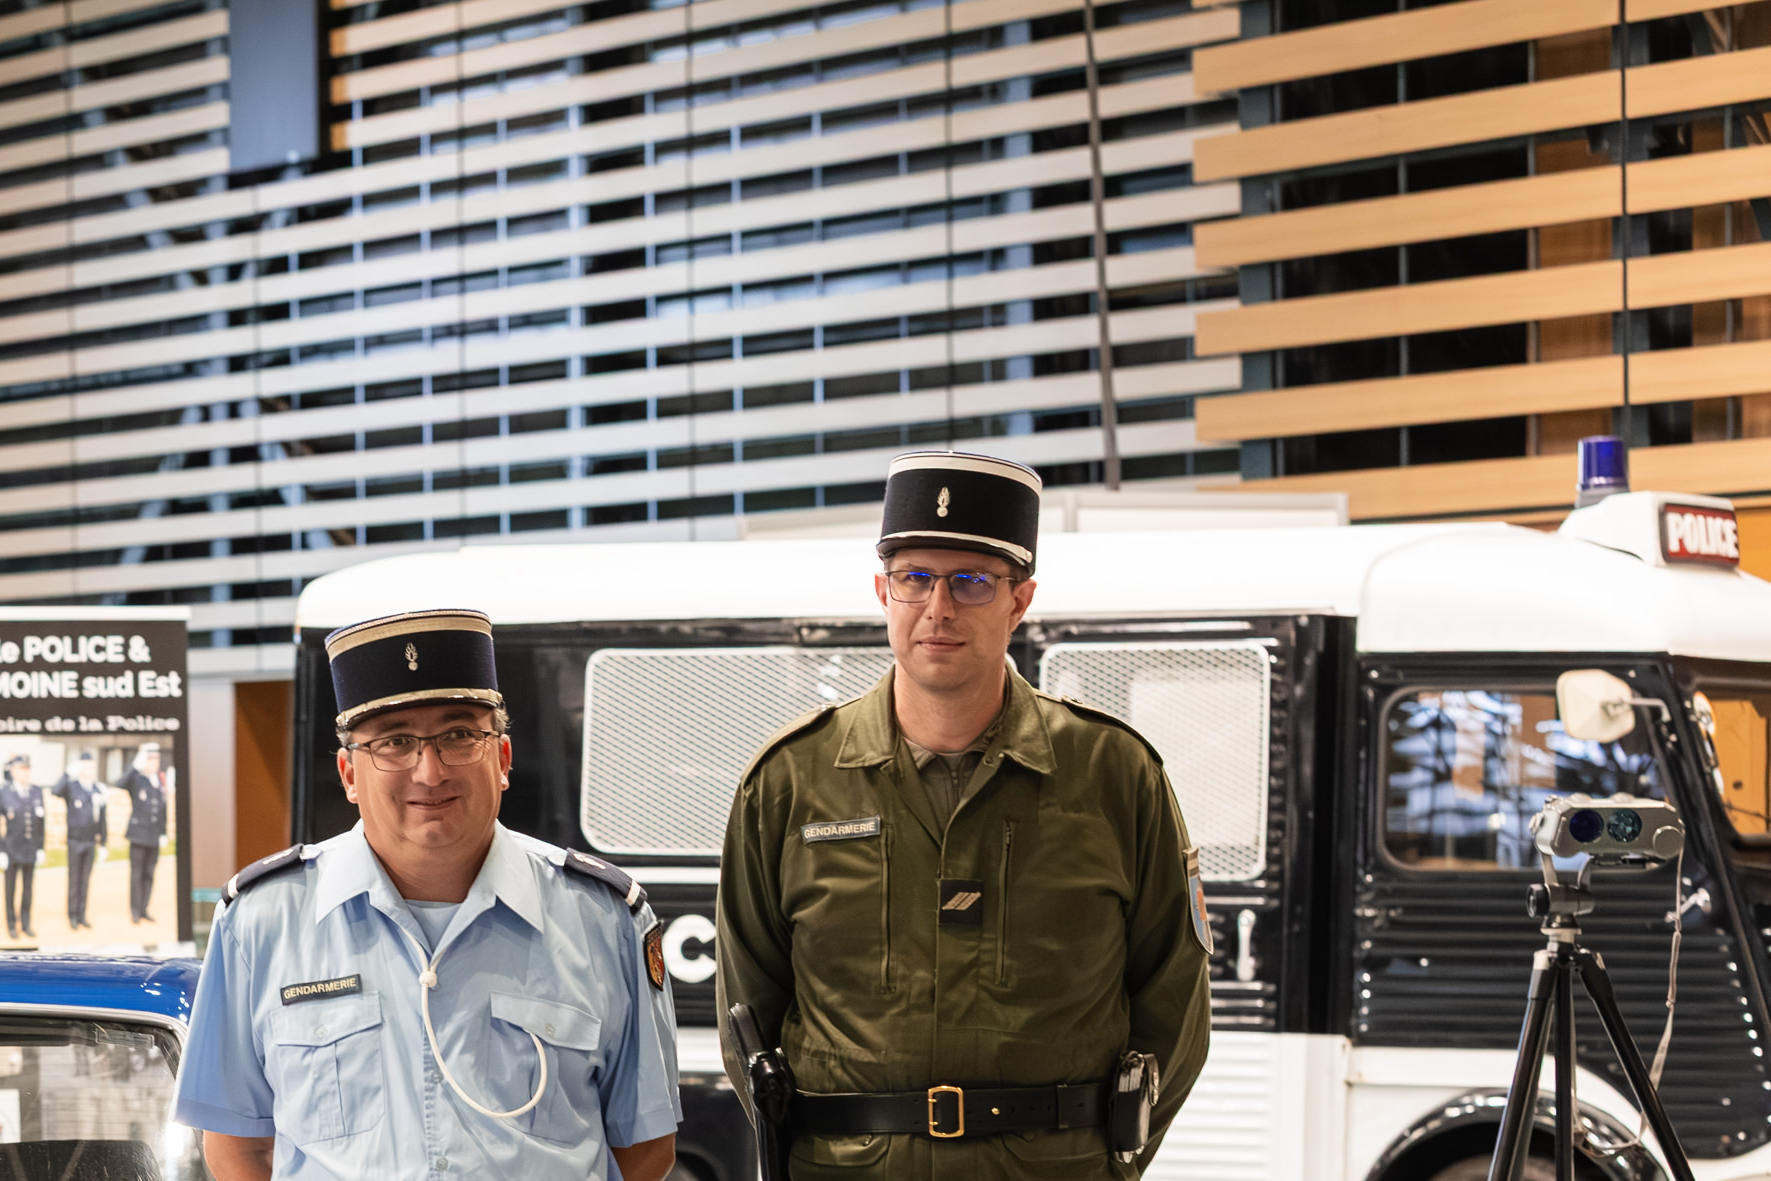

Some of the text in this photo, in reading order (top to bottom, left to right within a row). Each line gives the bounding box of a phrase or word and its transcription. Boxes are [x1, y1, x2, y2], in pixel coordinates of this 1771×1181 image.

[1666, 511, 1739, 558] POLICE
[24, 635, 125, 663] POLICE
[128, 635, 151, 663] &
[82, 670, 134, 699] sud
[138, 670, 182, 698] Est
[44, 715, 76, 732] de
[79, 715, 104, 732] la
[107, 714, 180, 732] Police
[803, 821, 876, 839] GENDARMERIE
[283, 977, 357, 1000] GENDARMERIE
